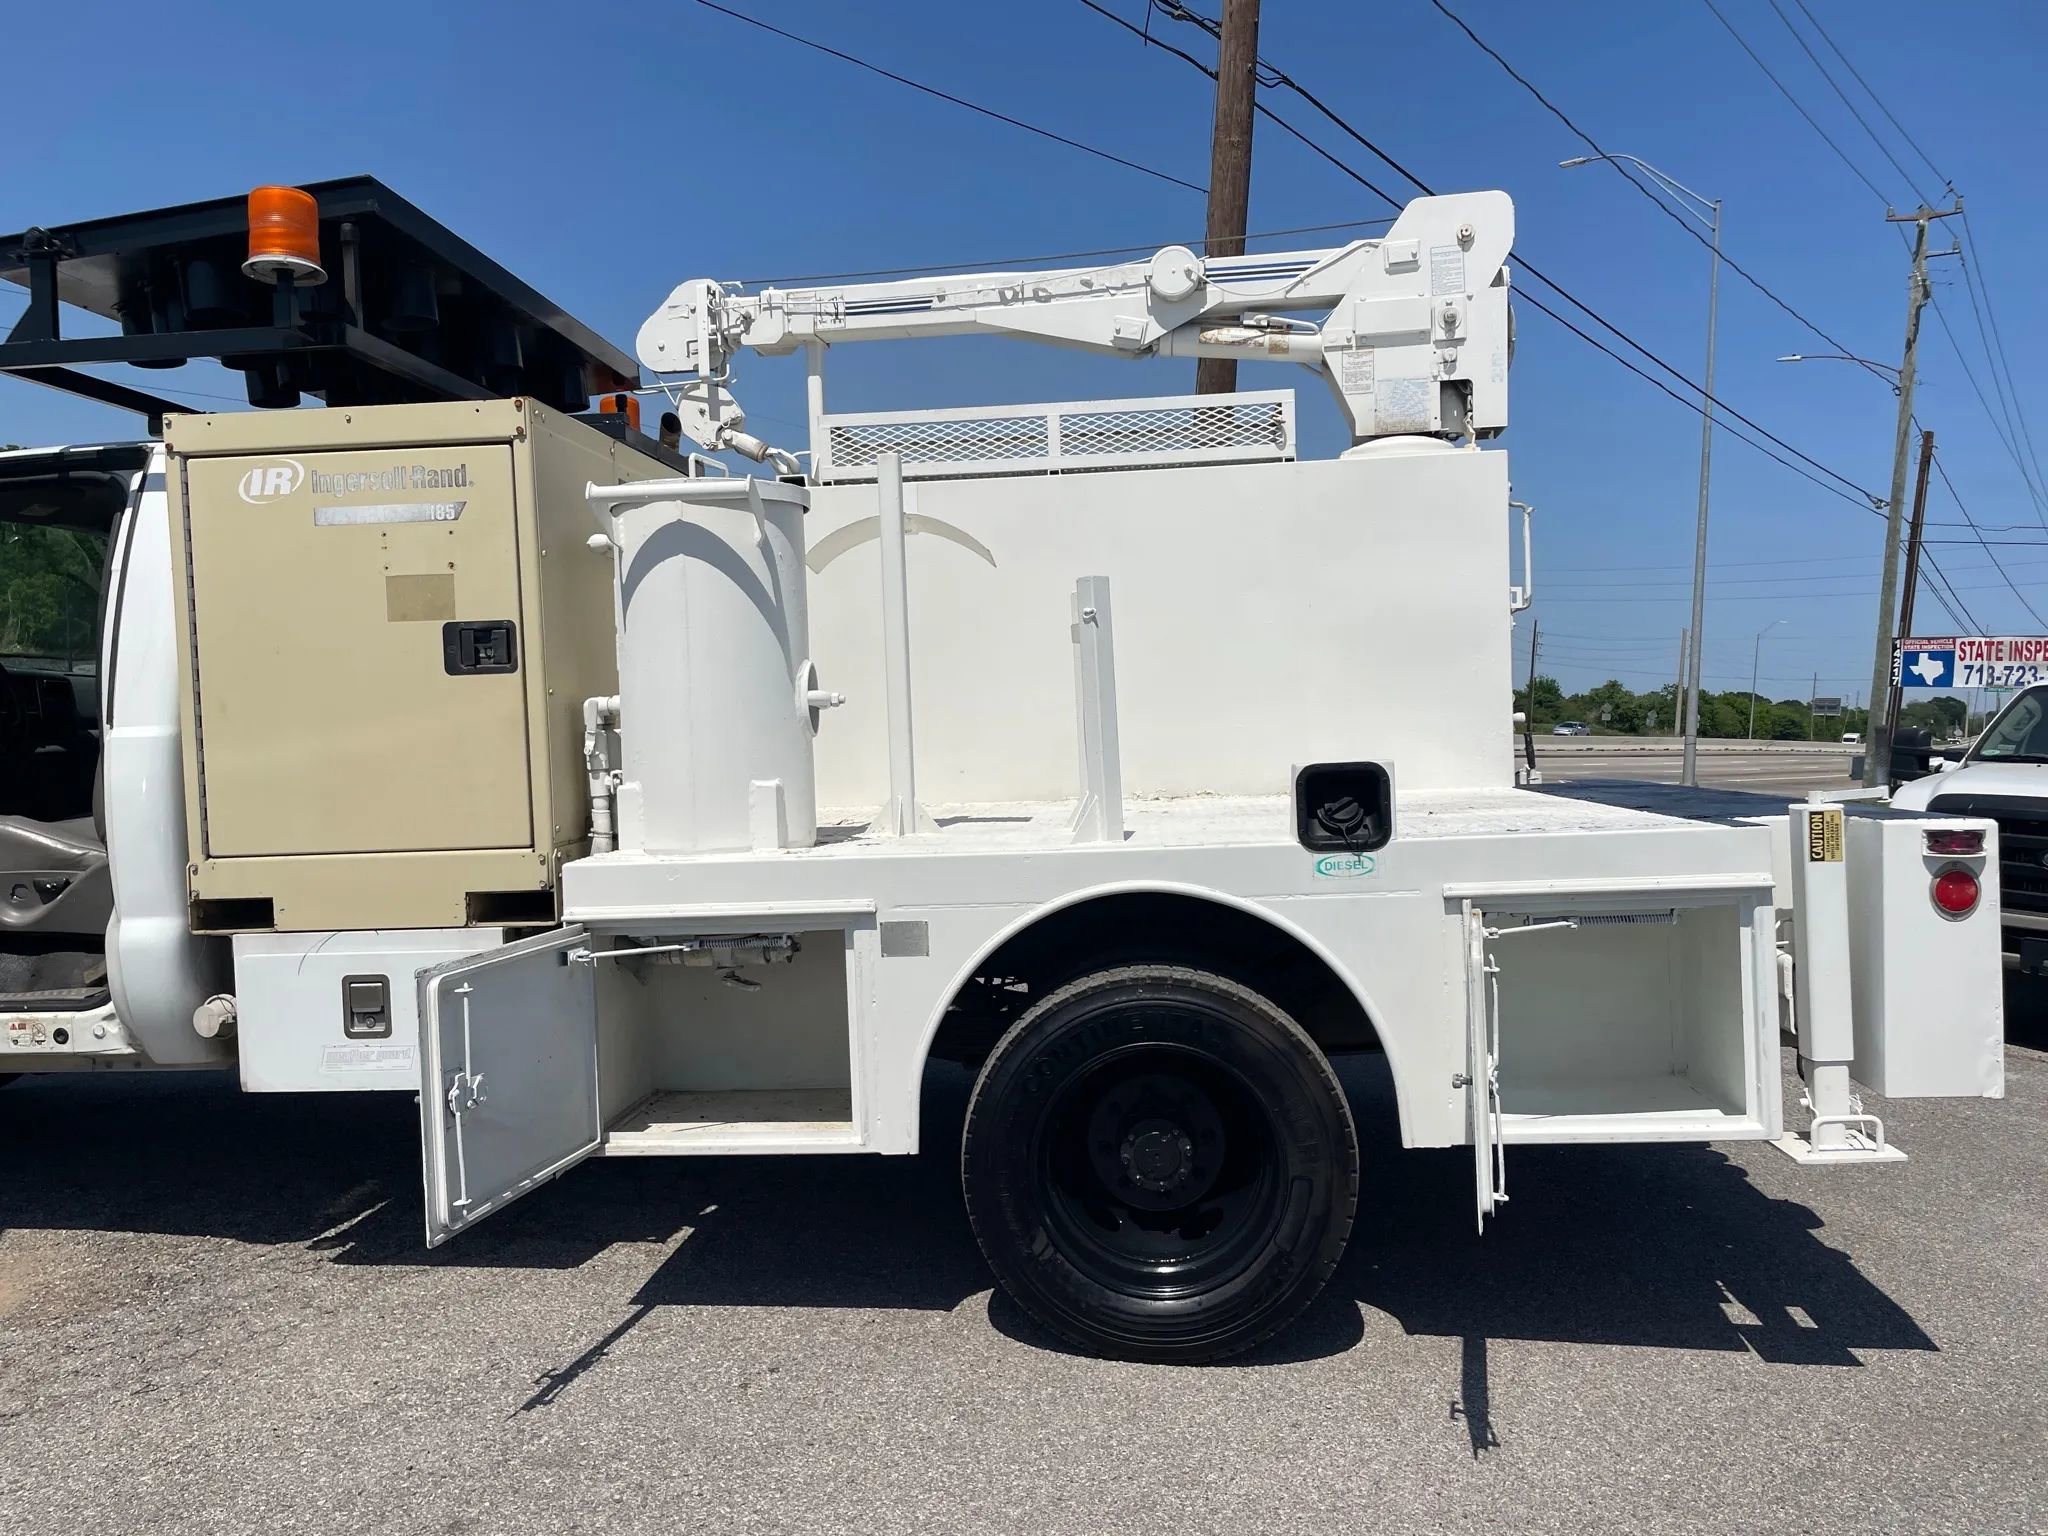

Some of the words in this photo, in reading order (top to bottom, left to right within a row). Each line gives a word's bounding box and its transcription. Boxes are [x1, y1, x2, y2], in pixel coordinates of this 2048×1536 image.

[311, 465, 406, 497] Ingersoll
[431, 503, 456, 521] 185
[1958, 641, 2003, 662] STATE
[2009, 640, 2048, 662] INSPE
[1963, 664, 2048, 687] 713-723-
[1811, 814, 1824, 859] CAUTION
[1324, 860, 1368, 872] DIESEL
